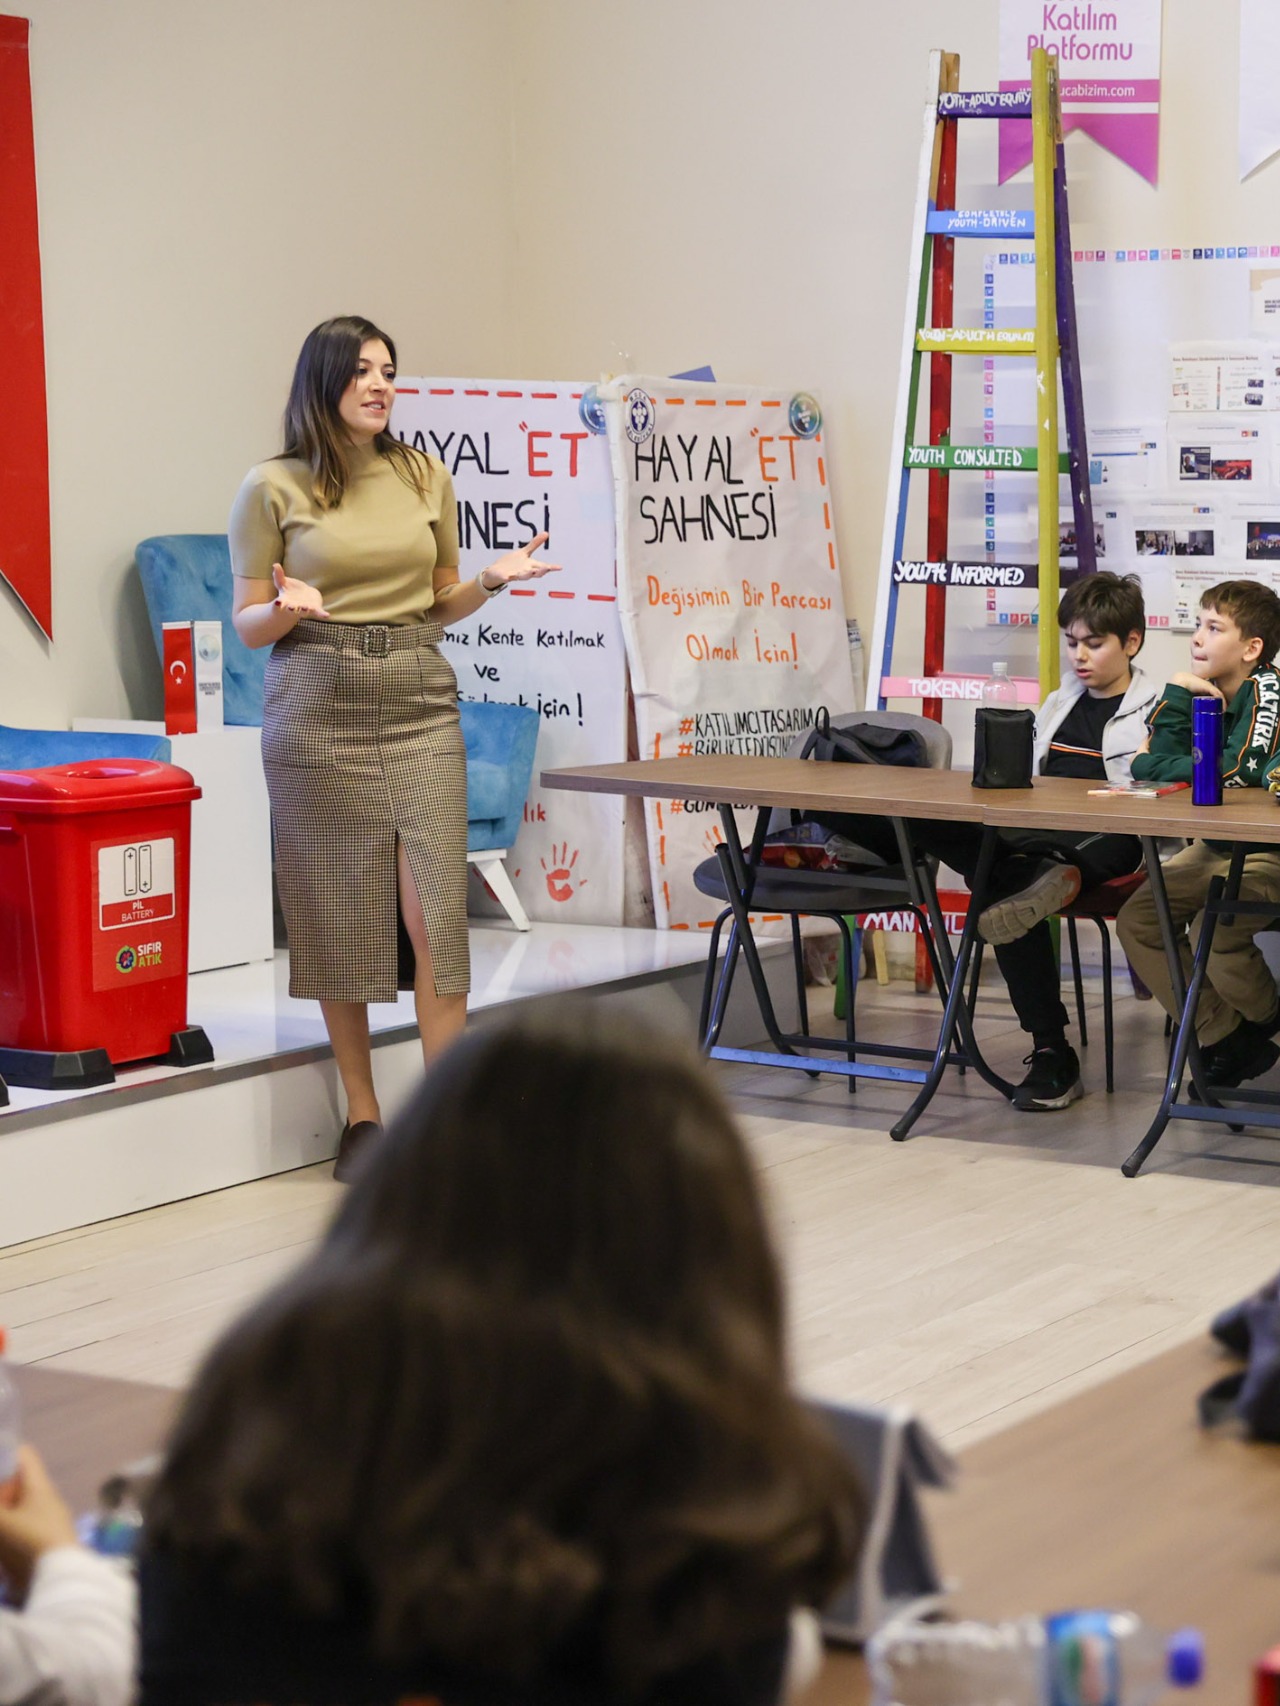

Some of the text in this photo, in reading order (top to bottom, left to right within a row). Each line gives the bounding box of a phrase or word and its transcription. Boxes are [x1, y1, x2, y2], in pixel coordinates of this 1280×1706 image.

[1043, 4, 1117, 31] Katılım
[948, 218, 1026, 230] YOUTH-DRIVEN
[636, 433, 743, 485] HAYAL
[908, 447, 1023, 467] YOUTH CONSULTED
[639, 485, 777, 545] SAHNESİ
[893, 561, 1025, 586] YOUTH INFORMED
[647, 575, 731, 616] Değişimin
[742, 579, 765, 607] Bir
[478, 623, 526, 647] Kente
[537, 628, 607, 649] Katılmak
[473, 663, 500, 682] ve
[1252, 672, 1280, 754] OCATÜRK
[121, 909, 155, 922] BATTERY
[132, 900, 144, 910] PİL
[137, 941, 162, 956] SIFIR
[138, 953, 162, 968] ATIK
